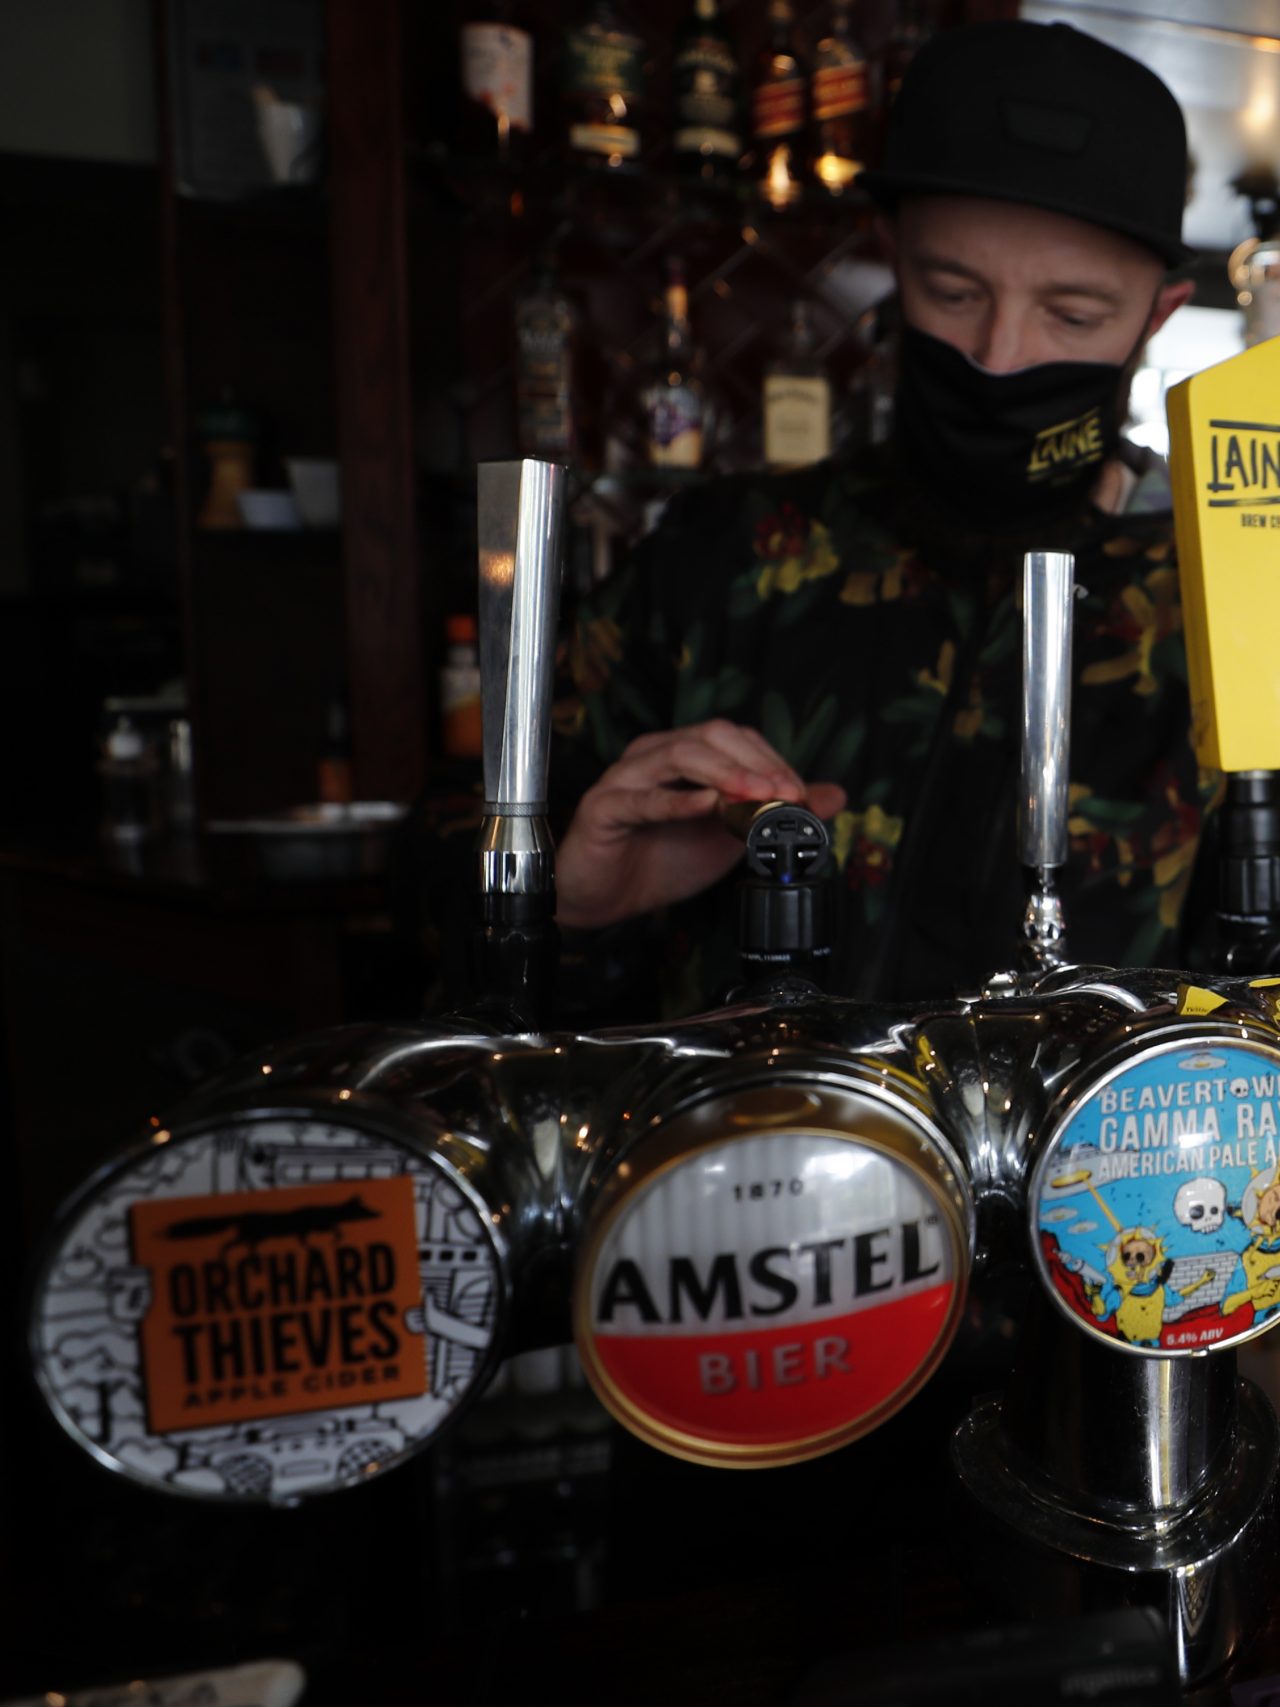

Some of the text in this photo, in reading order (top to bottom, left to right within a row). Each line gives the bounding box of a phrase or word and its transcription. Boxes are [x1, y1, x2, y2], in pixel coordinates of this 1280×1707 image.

[1027, 418, 1102, 472] LAINE
[1101, 1106, 1221, 1152] GAMMA
[1100, 1150, 1202, 1180] AMERICAN
[1209, 1141, 1258, 1169] PALE
[168, 1242, 398, 1320] ORCHARD
[597, 1217, 940, 1324] AMSTEL
[174, 1301, 400, 1384] THIEVES
[1200, 1327, 1224, 1341] ABV
[185, 1366, 399, 1409] APPLE CIDER
[700, 1335, 853, 1396] BIER
